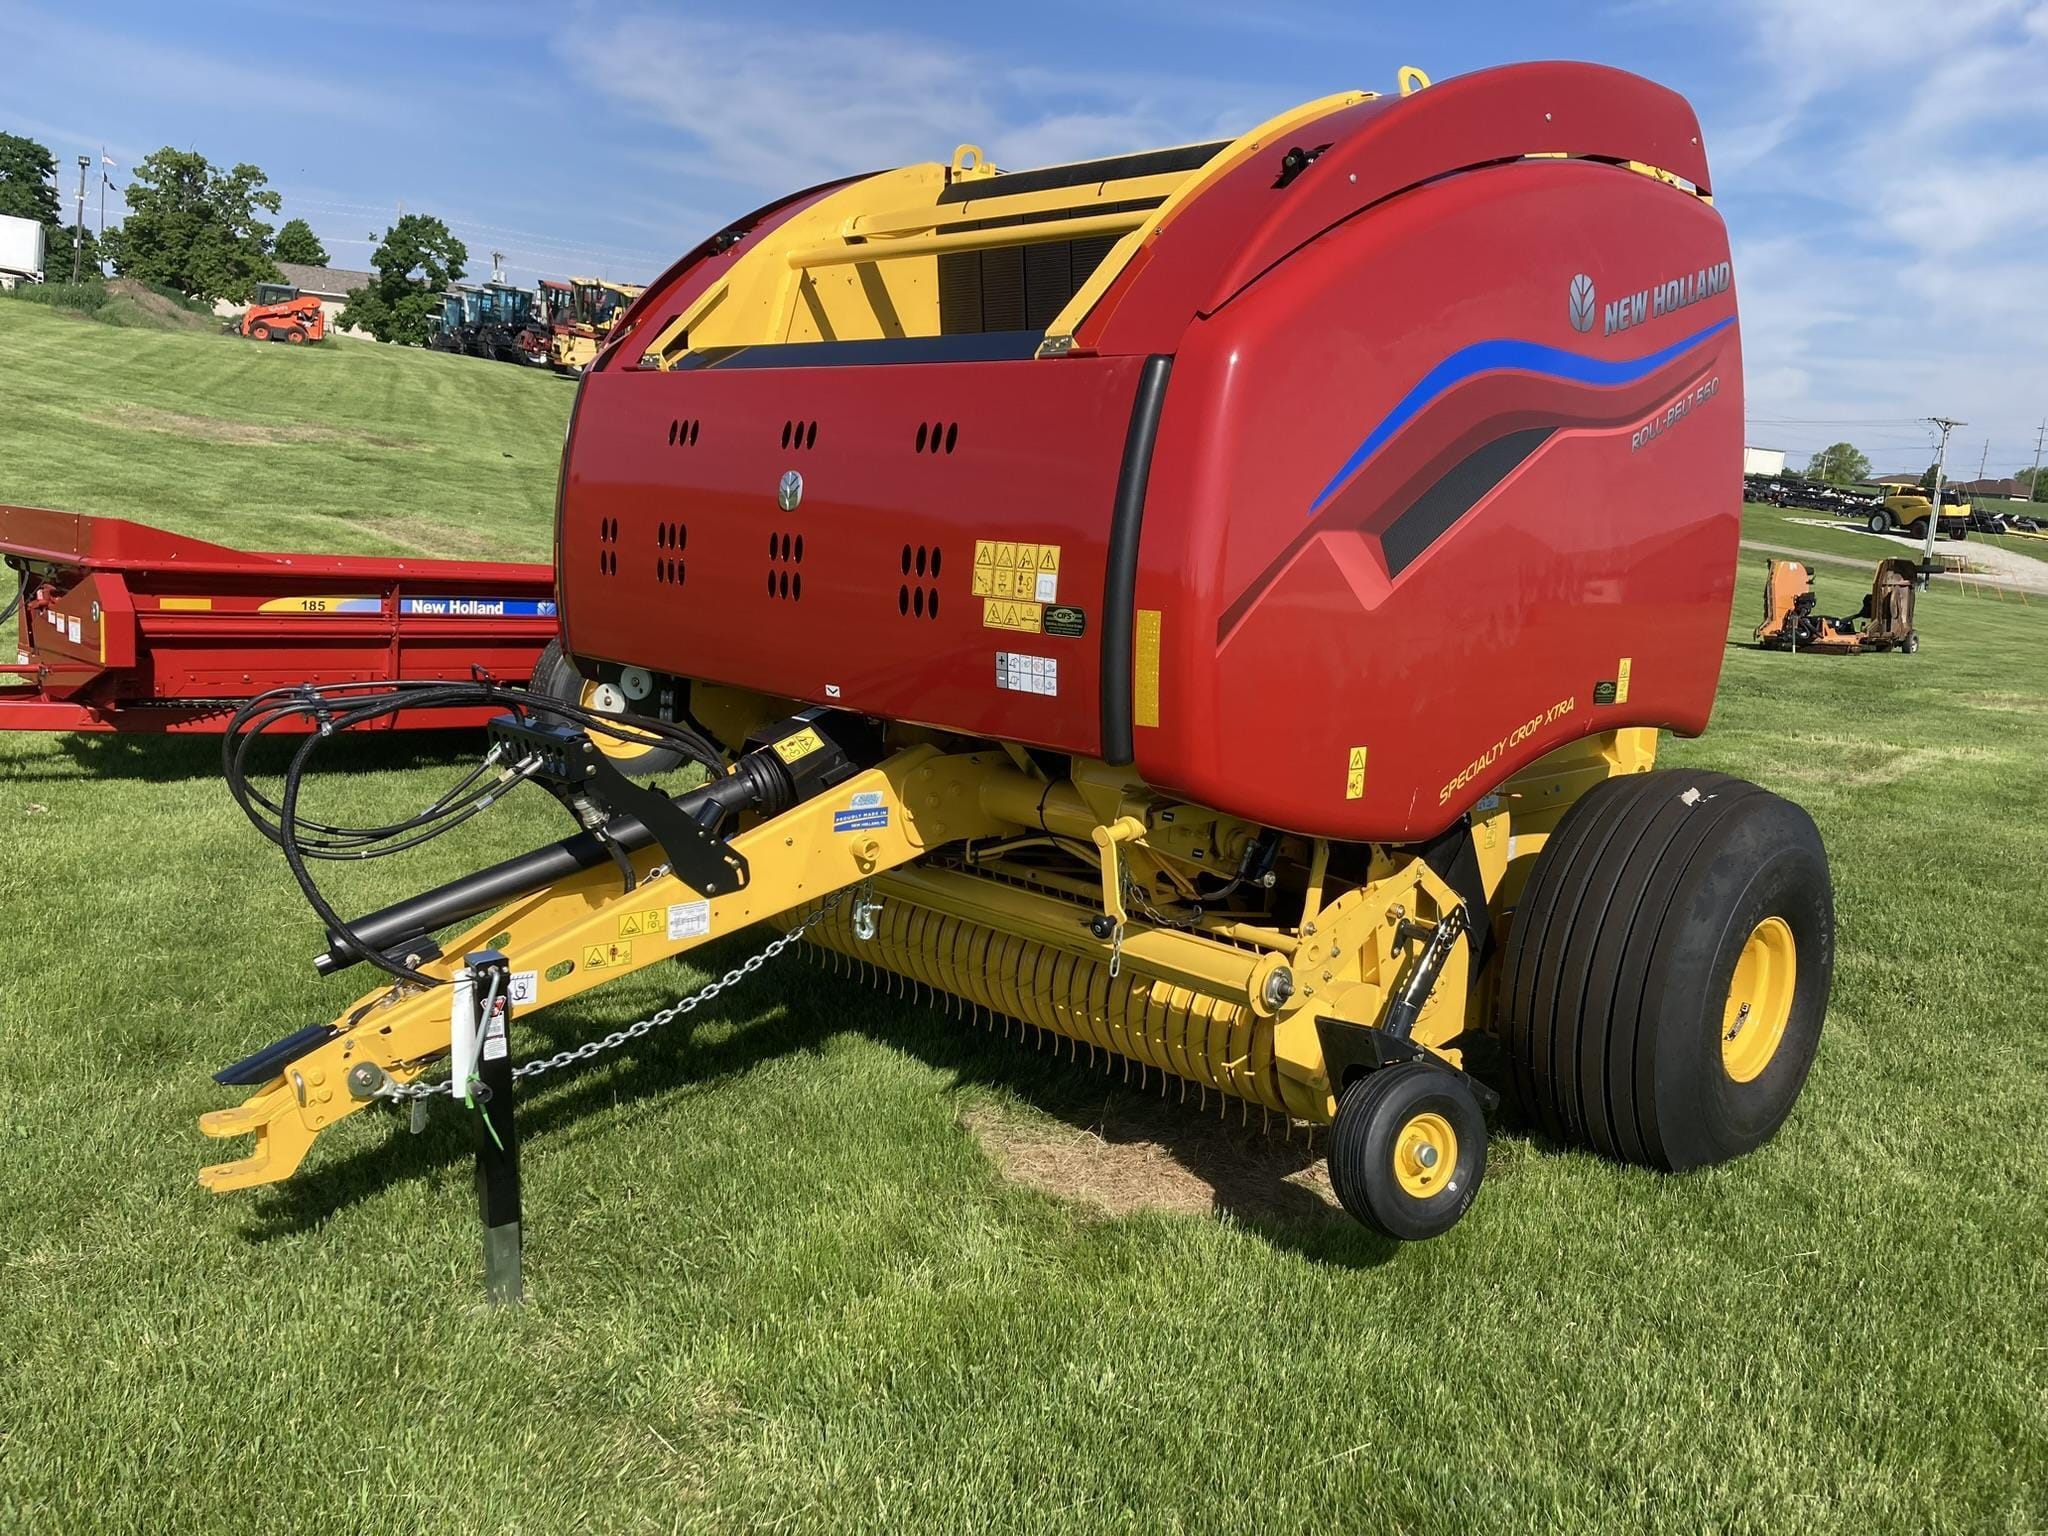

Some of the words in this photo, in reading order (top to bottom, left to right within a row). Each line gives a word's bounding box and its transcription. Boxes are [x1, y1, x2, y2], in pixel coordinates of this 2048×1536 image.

[1604, 290, 1649, 336] NEW
[1652, 261, 1730, 318] HOLLAND
[1631, 393, 1694, 453] ROLL-BELT
[301, 600, 326, 612] 185
[411, 600, 443, 614] New
[449, 600, 504, 615] Holland
[1439, 737, 1508, 807] SPECIALTY
[1509, 714, 1543, 748] CROP
[1544, 696, 1575, 726] XTRA
